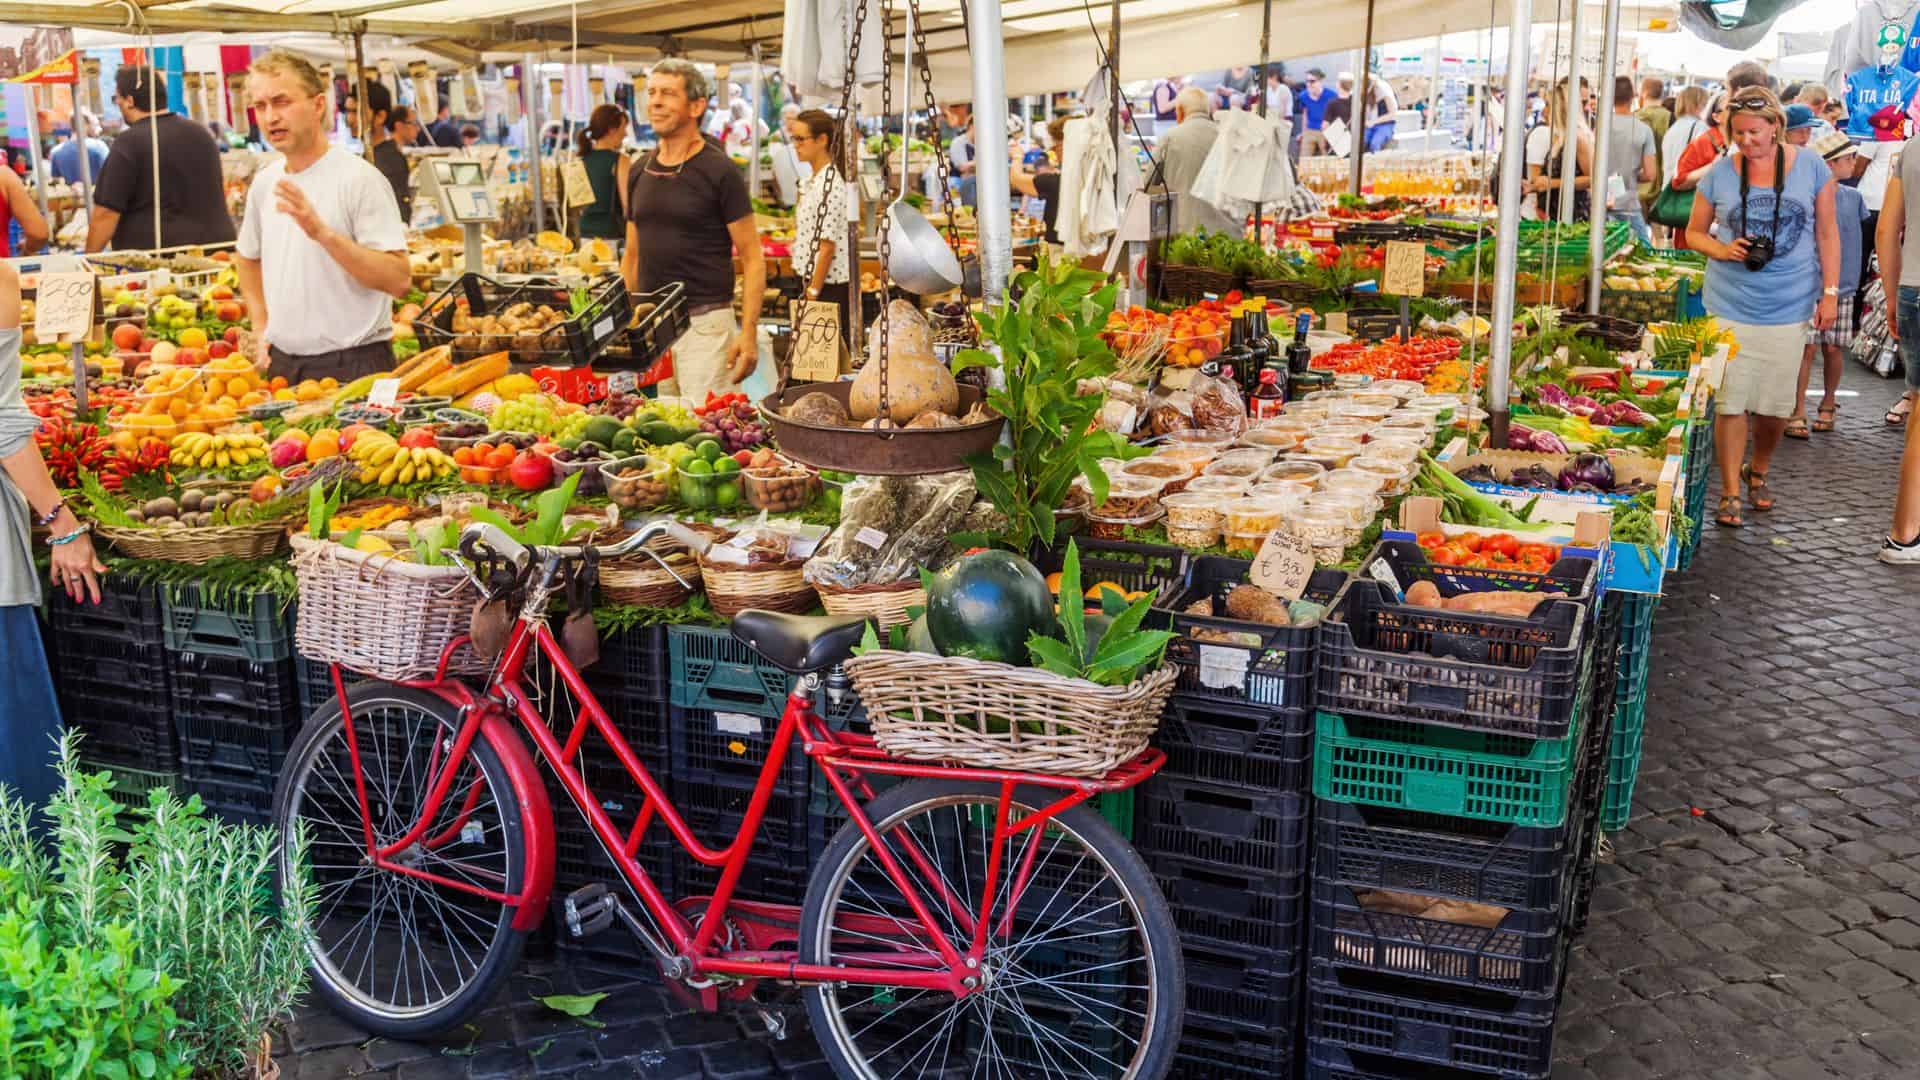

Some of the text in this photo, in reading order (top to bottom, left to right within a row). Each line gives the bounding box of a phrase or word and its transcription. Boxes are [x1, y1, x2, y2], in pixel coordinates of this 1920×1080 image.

[1859, 88, 1902, 104] ITA LIA
[1260, 551, 1283, 578] €
